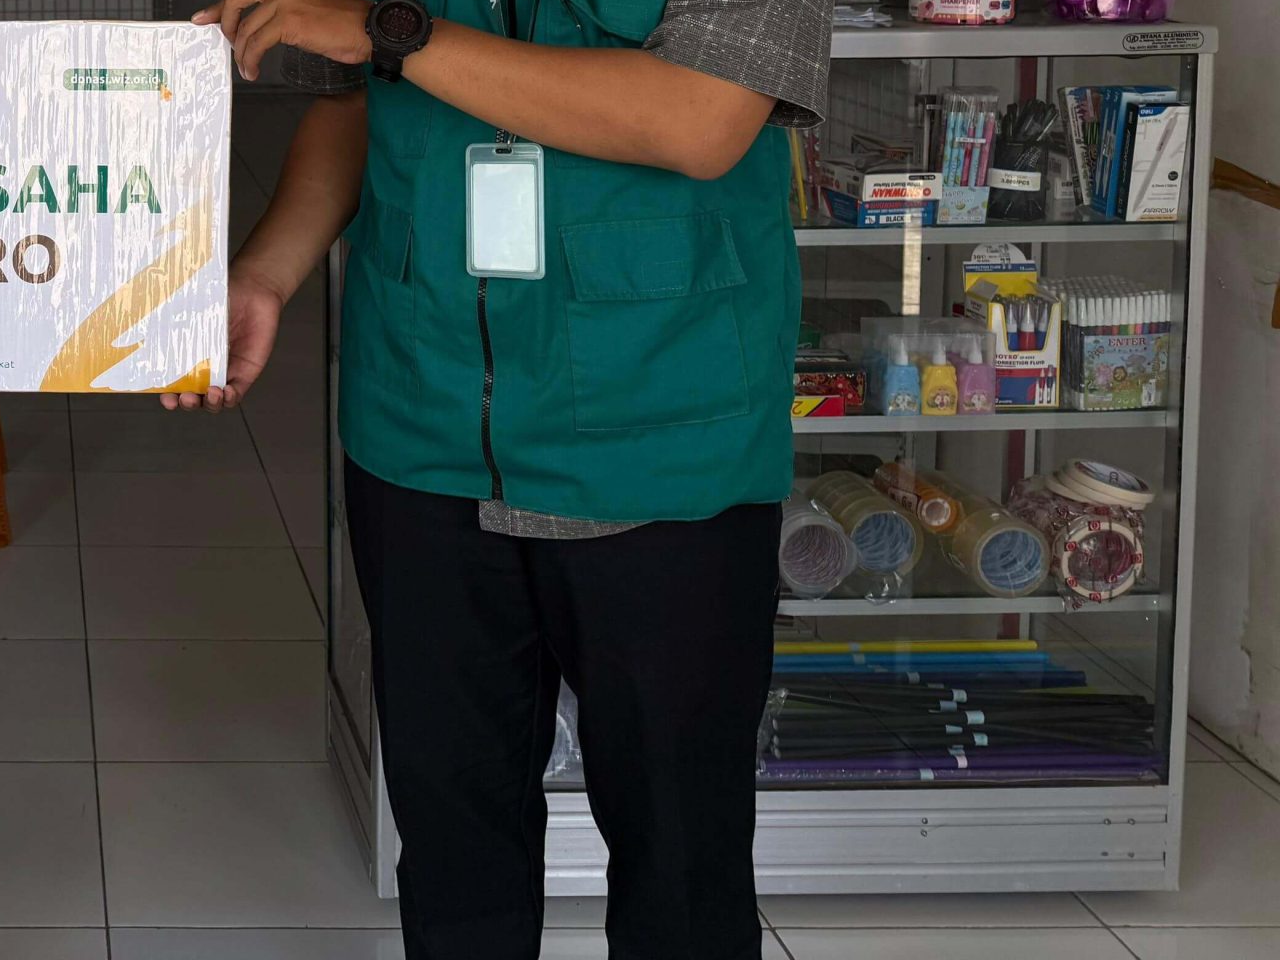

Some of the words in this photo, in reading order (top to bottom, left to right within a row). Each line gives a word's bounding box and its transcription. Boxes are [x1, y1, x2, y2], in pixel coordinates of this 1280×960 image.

[70, 72, 160, 85] donasi.wiz.or.id
[871, 188, 923, 198] SNOWMAN
[1108, 337, 1146, 347] ENTER
